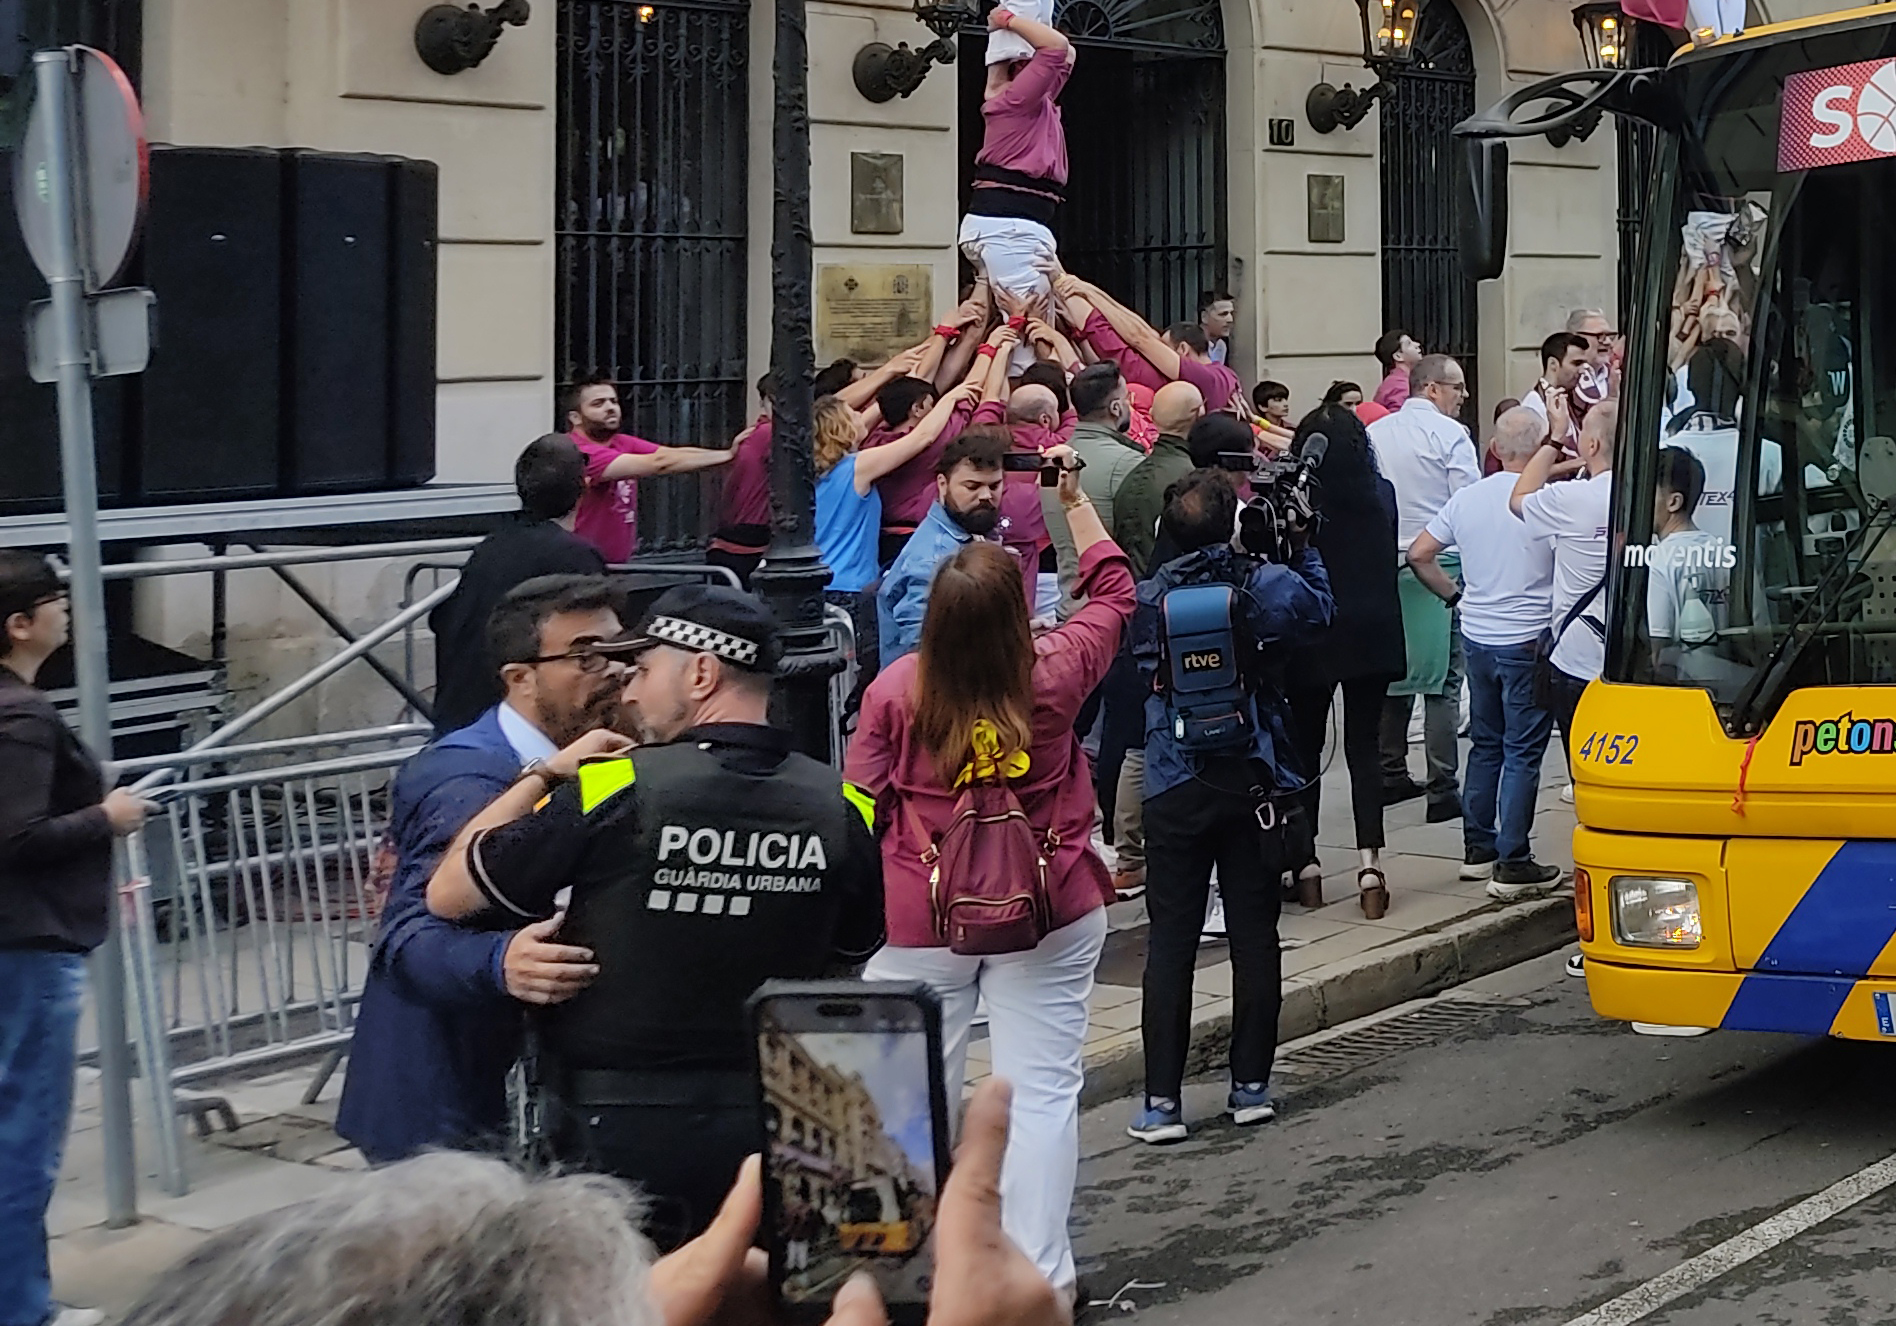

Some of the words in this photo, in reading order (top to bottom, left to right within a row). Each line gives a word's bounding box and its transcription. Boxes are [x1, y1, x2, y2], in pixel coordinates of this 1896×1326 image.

[1271, 119, 1293, 144] 10
[1623, 536, 1738, 569] moventis
[1184, 653, 1221, 669] rtve
[1578, 731, 1639, 765] 4152
[657, 825, 828, 871] POLICIA
[653, 865, 743, 890] GUÀRDIA
[746, 874, 822, 893] URBANA
